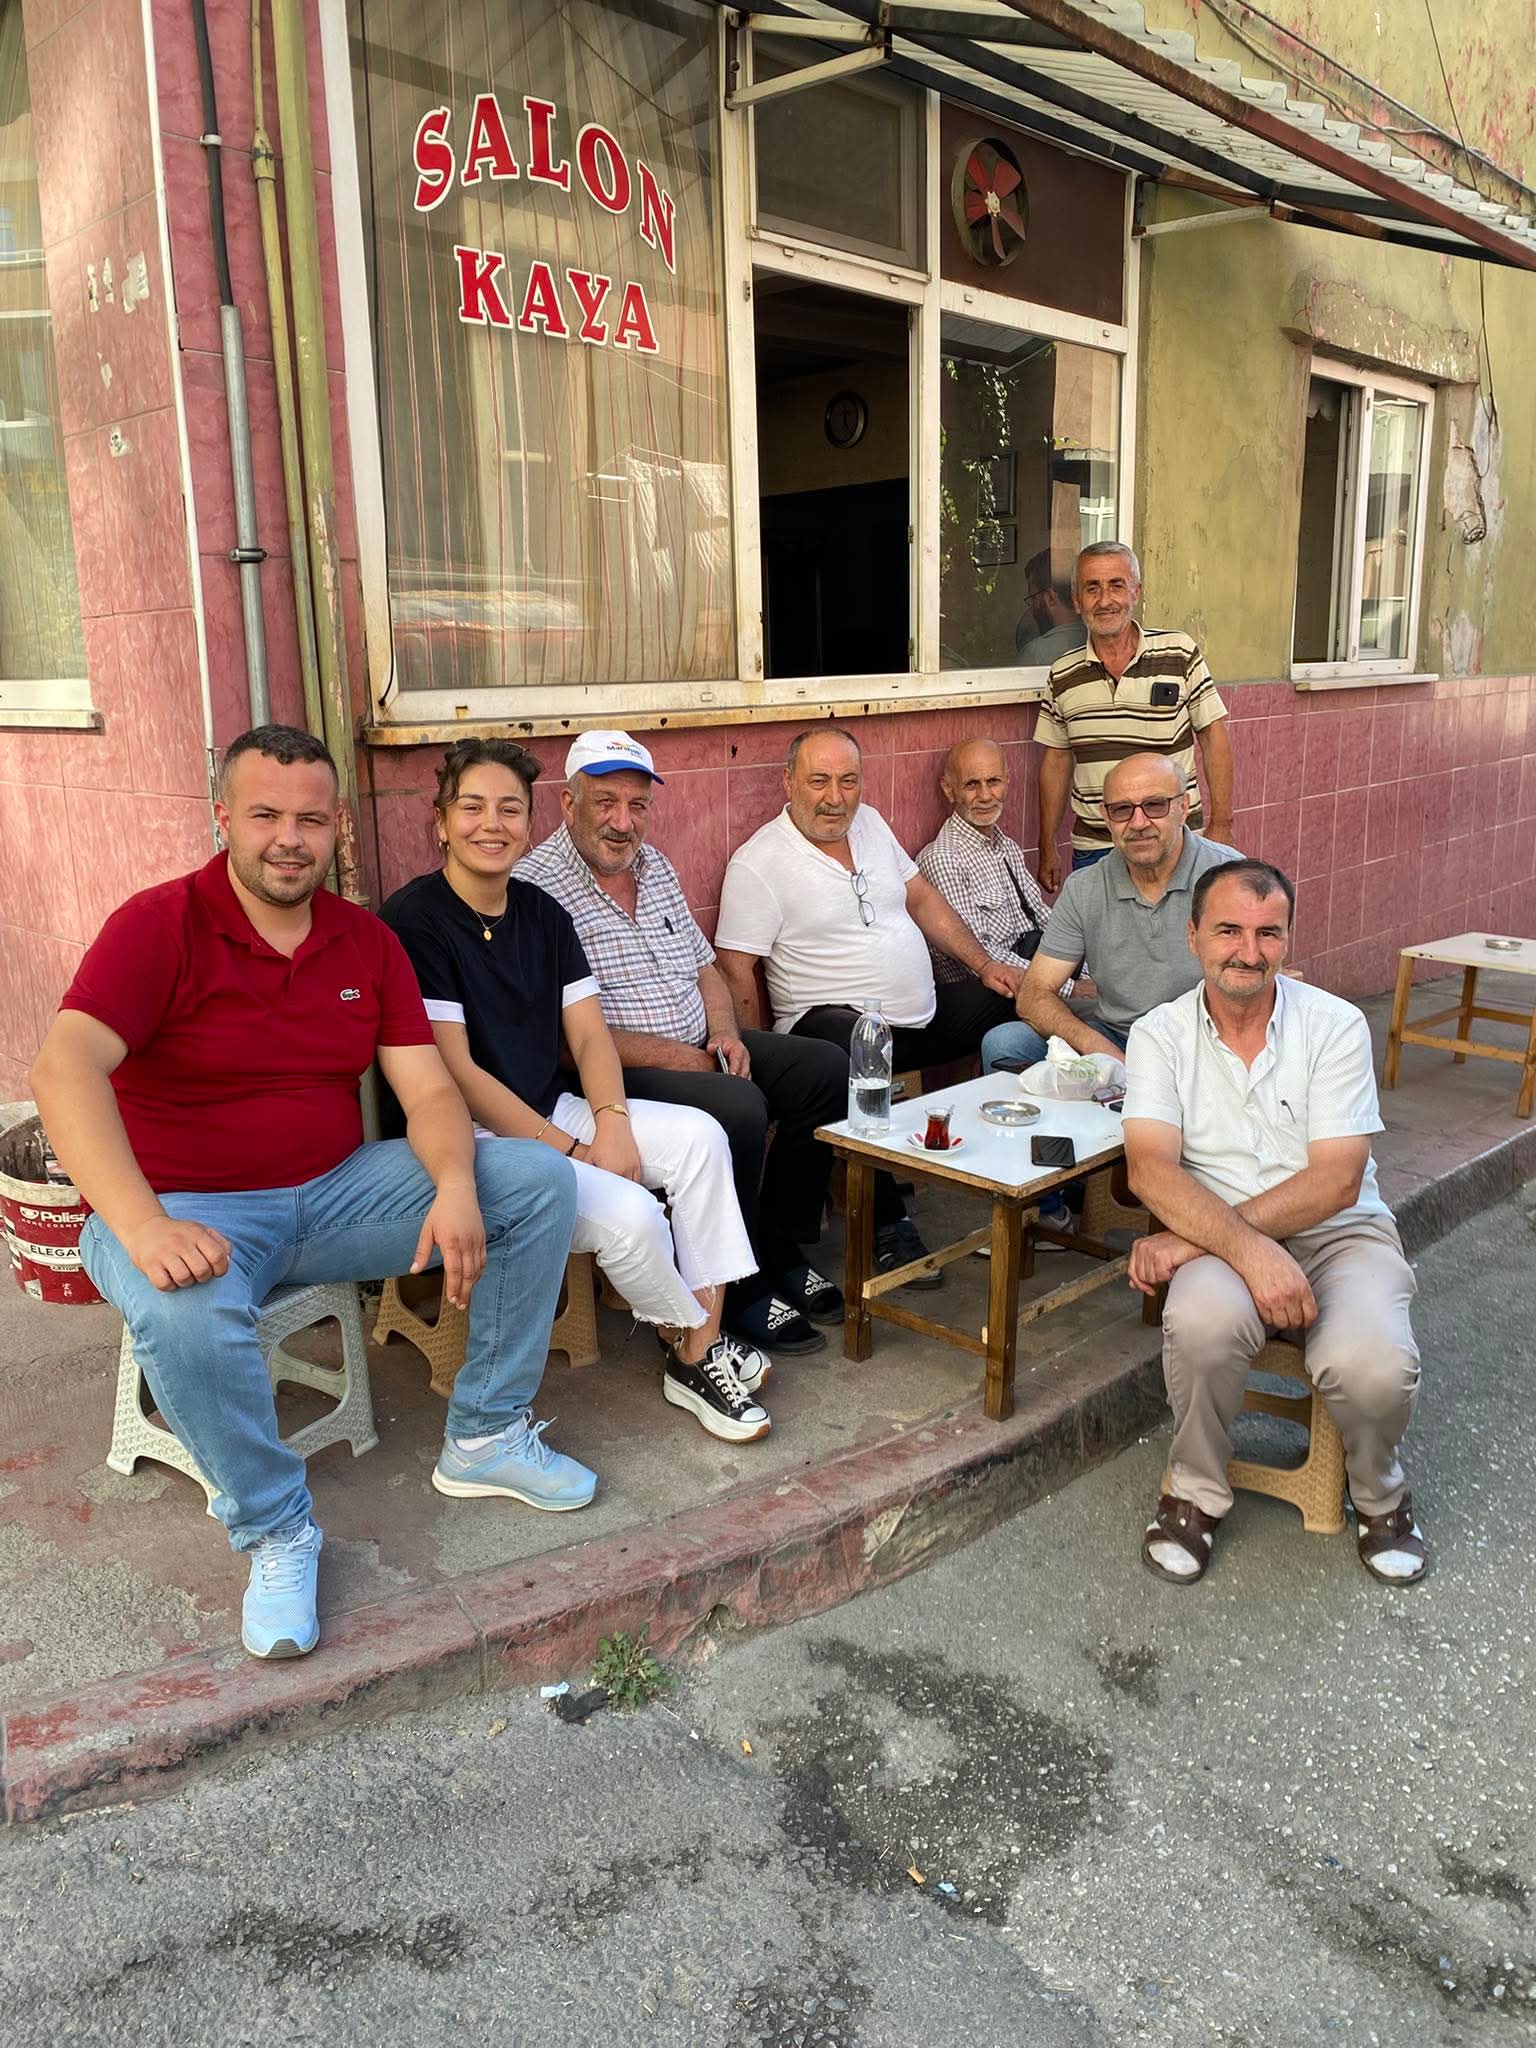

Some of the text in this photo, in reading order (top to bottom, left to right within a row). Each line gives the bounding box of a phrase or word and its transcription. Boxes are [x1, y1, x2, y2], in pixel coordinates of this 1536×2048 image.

[413, 93, 676, 275] SALON
[453, 244, 660, 353] KAYA
[767, 1309, 800, 1329] adidas
[804, 1281, 834, 1295] adidas
